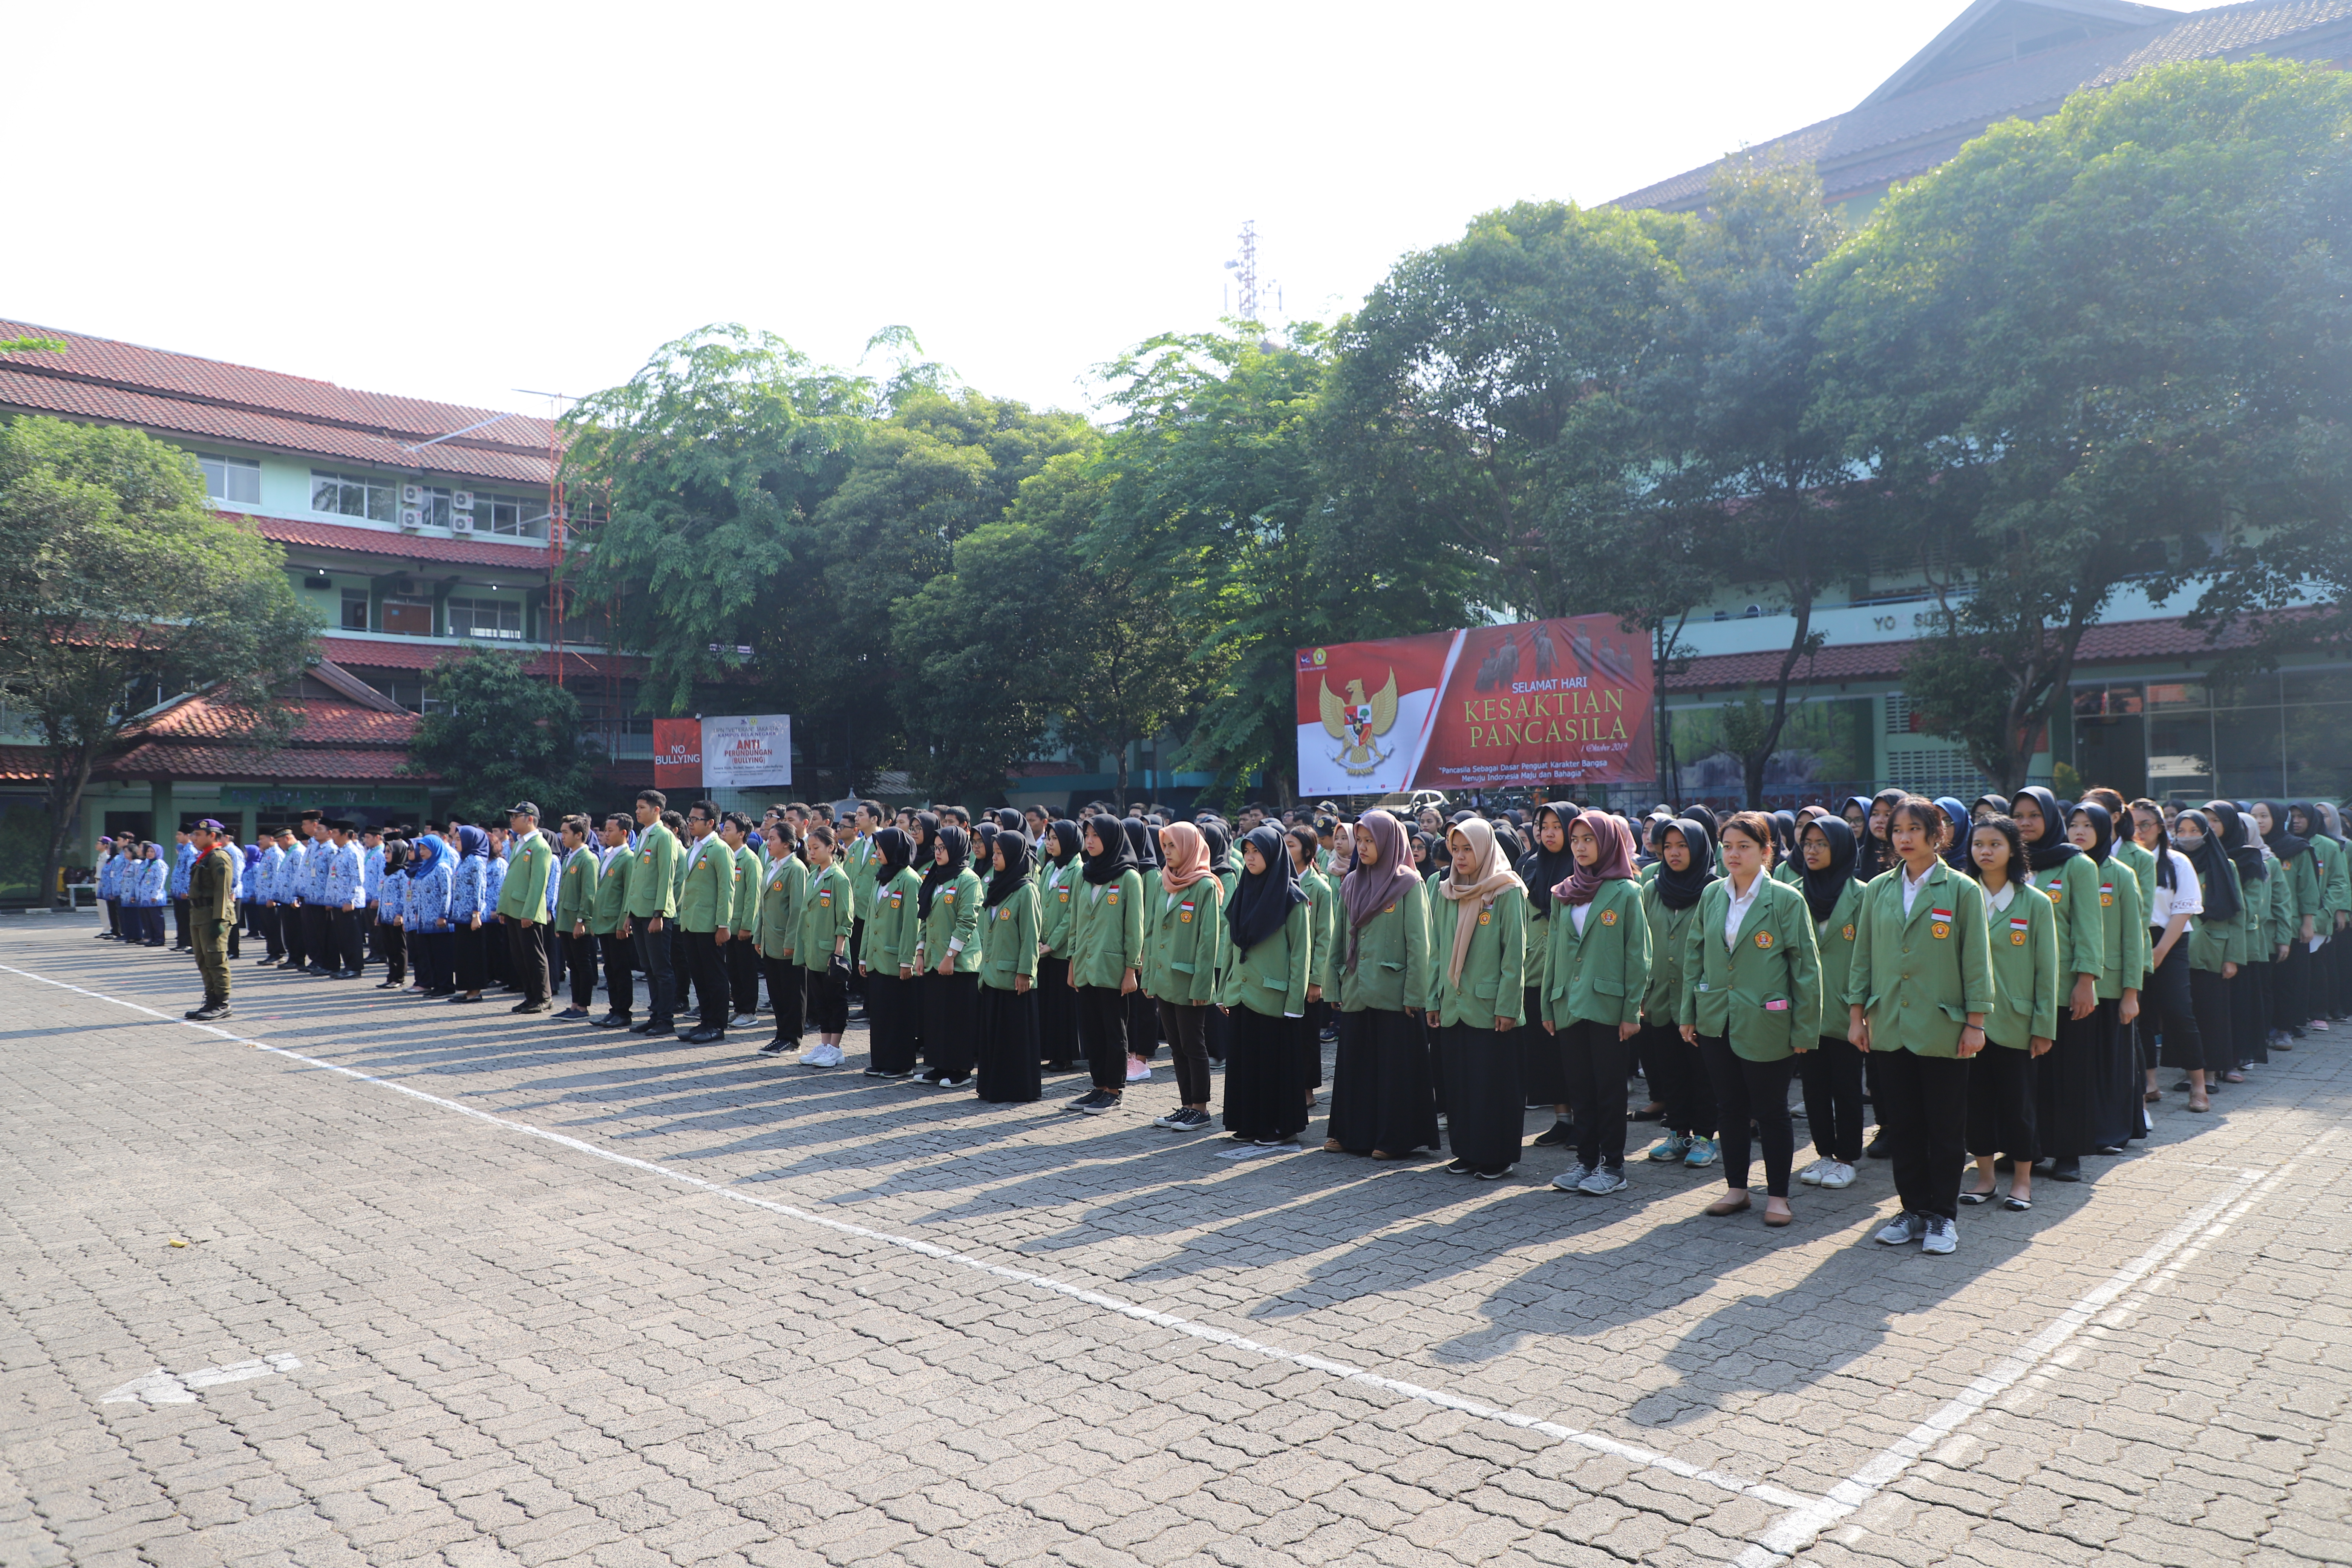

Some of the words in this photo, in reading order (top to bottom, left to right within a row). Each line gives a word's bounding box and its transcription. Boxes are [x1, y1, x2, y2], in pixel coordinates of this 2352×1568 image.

[1512, 678, 1558, 694] SELAMAT
[1561, 677, 1587, 689] HARI
[1464, 688, 1624, 722] KESAKTIAN
[1470, 715, 1628, 747] PANCASILA
[671, 745, 686, 754] NO
[737, 740, 760, 749] ANTI
[1586, 743, 1611, 753] Oktober
[1611, 743, 1628, 752] 2019
[655, 754, 700, 765] BULLYING
[732, 756, 766, 766] (BULLYING)
[1439, 766, 1471, 774] "Pancasila
[1472, 765, 1498, 773] Sebagai
[1582, 759, 1608, 767] Bangsa
[1521, 772, 1537, 780] Maju
[1554, 769, 1585, 779] Bahagia"
